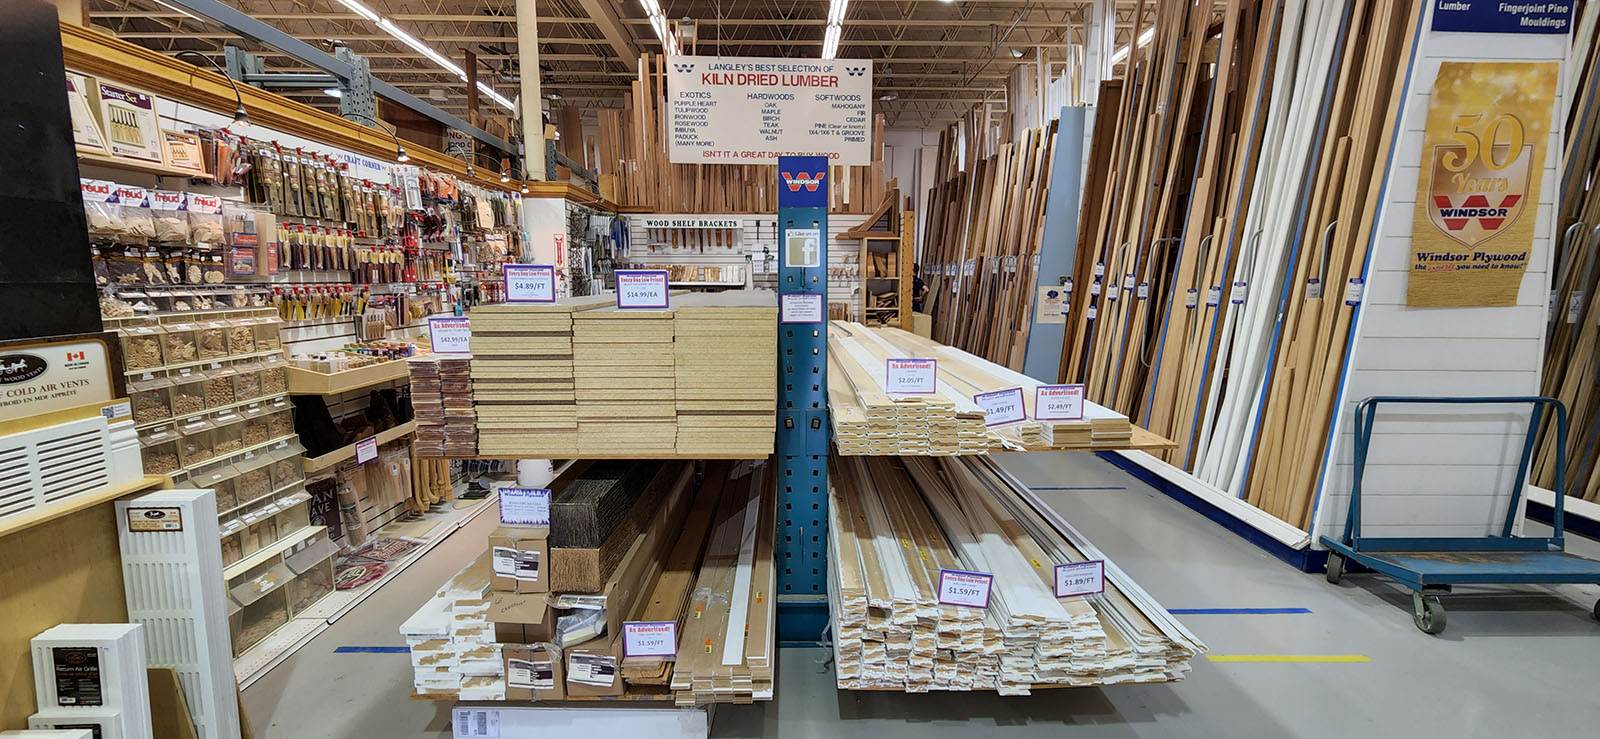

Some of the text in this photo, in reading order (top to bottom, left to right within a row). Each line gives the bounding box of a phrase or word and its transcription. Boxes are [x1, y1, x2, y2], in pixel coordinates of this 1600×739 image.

[1439, 1, 1471, 11] Lumber
[1498, 3, 1568, 15] Fingerjoint Pine
[1520, 17, 1566, 29] Mouldings
[708, 63, 753, 71] LANGLEY'S
[778, 64, 821, 72] SELECTION
[702, 73, 838, 87] KILN DRIED LUMBER
[1442, 113, 1524, 173] 50
[344, 154, 381, 170] CRAFT CORNER
[1452, 172, 1509, 193] Years
[117, 187, 143, 200] freud
[154, 192, 180, 204] freud
[194, 196, 217, 208] freud
[1440, 208, 1508, 217] WINDSOR
[1416, 252, 1526, 263] Windsor Plywood
[514, 282, 545, 290] $4.89/FT
[4, 365, 44, 382] WOOD VENTS
[6, 378, 90, 398] COLD AIR VENTS
[1064, 577, 1094, 587] $1.89/FT
[948, 587, 980, 597] $1.59/FT
